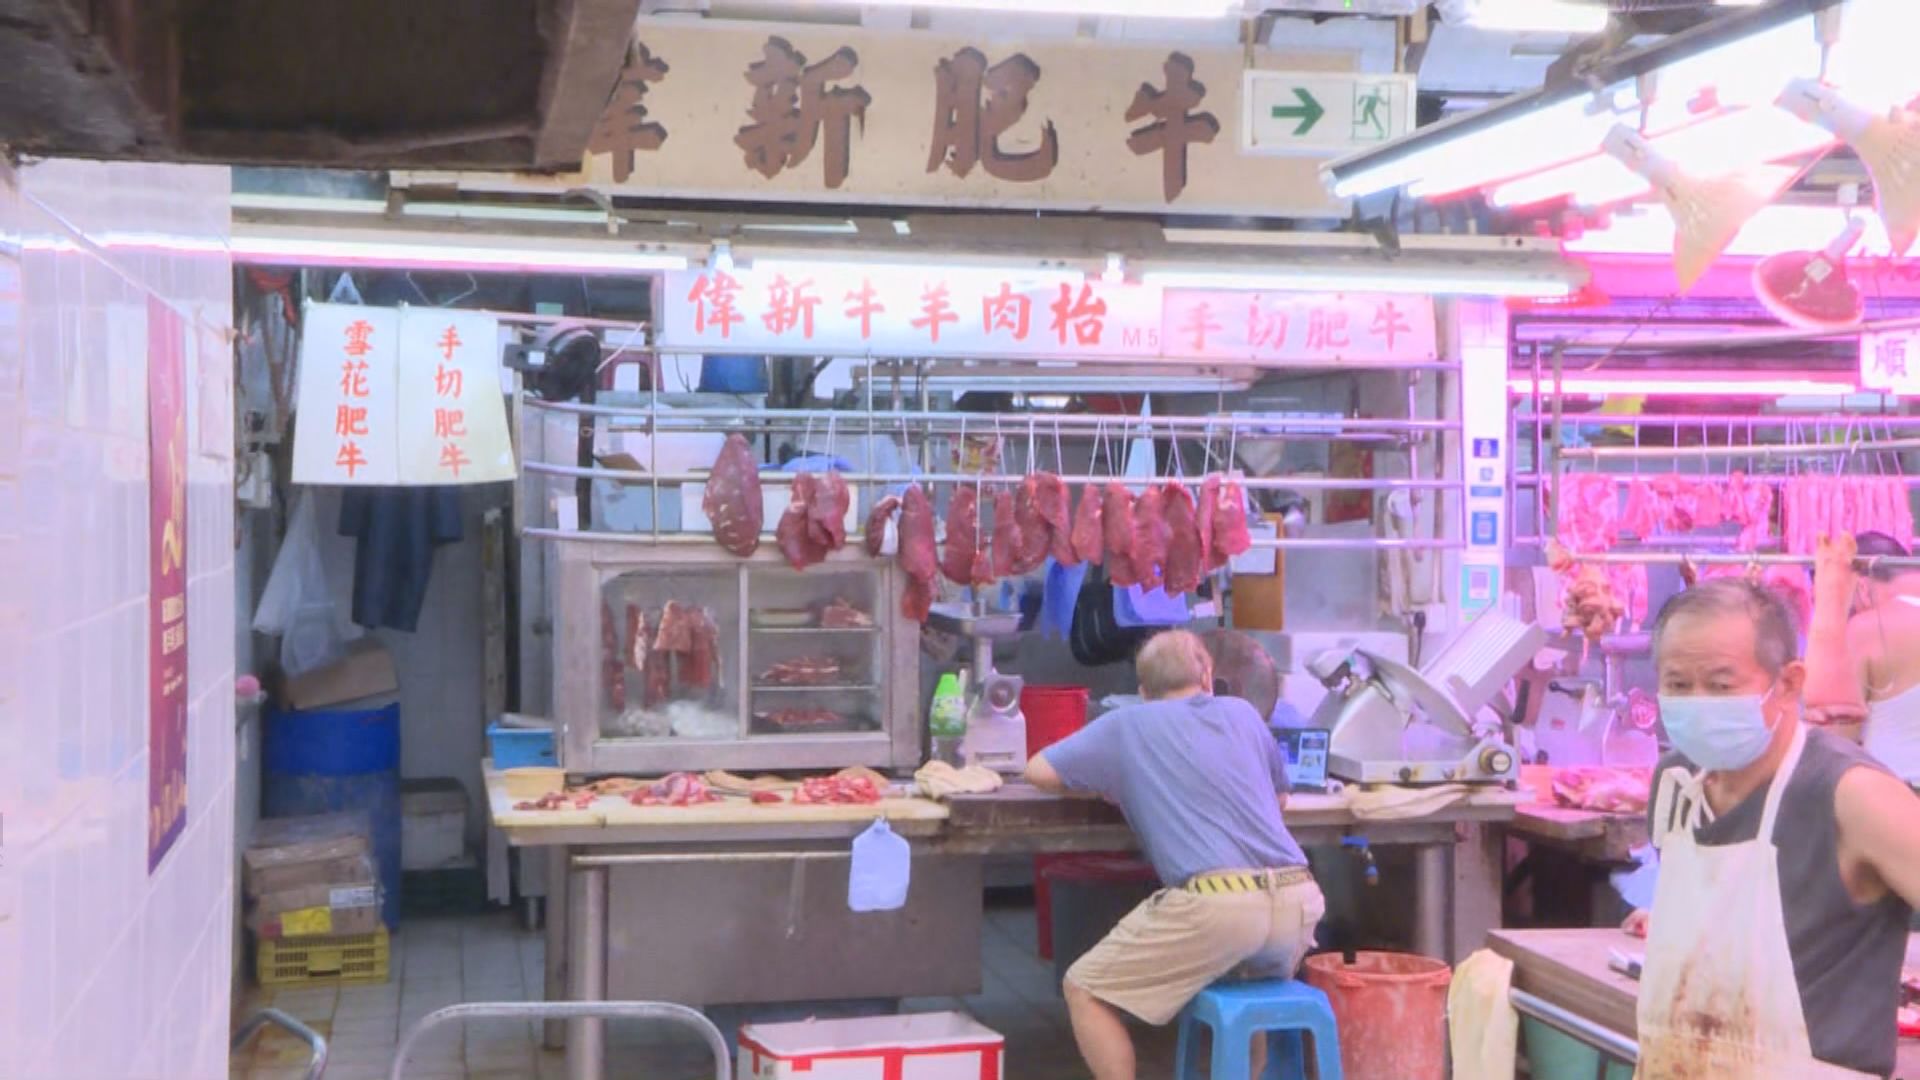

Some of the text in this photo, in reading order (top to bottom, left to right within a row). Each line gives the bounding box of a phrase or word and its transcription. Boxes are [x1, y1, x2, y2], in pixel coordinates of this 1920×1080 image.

[688, 270, 1107, 346] 偉新牛羊肉枱
[1179, 301, 1412, 351] 手切肥牛
[335, 319, 375, 479] 雪花肥牛
[433, 323, 472, 478] 手切肥牛
